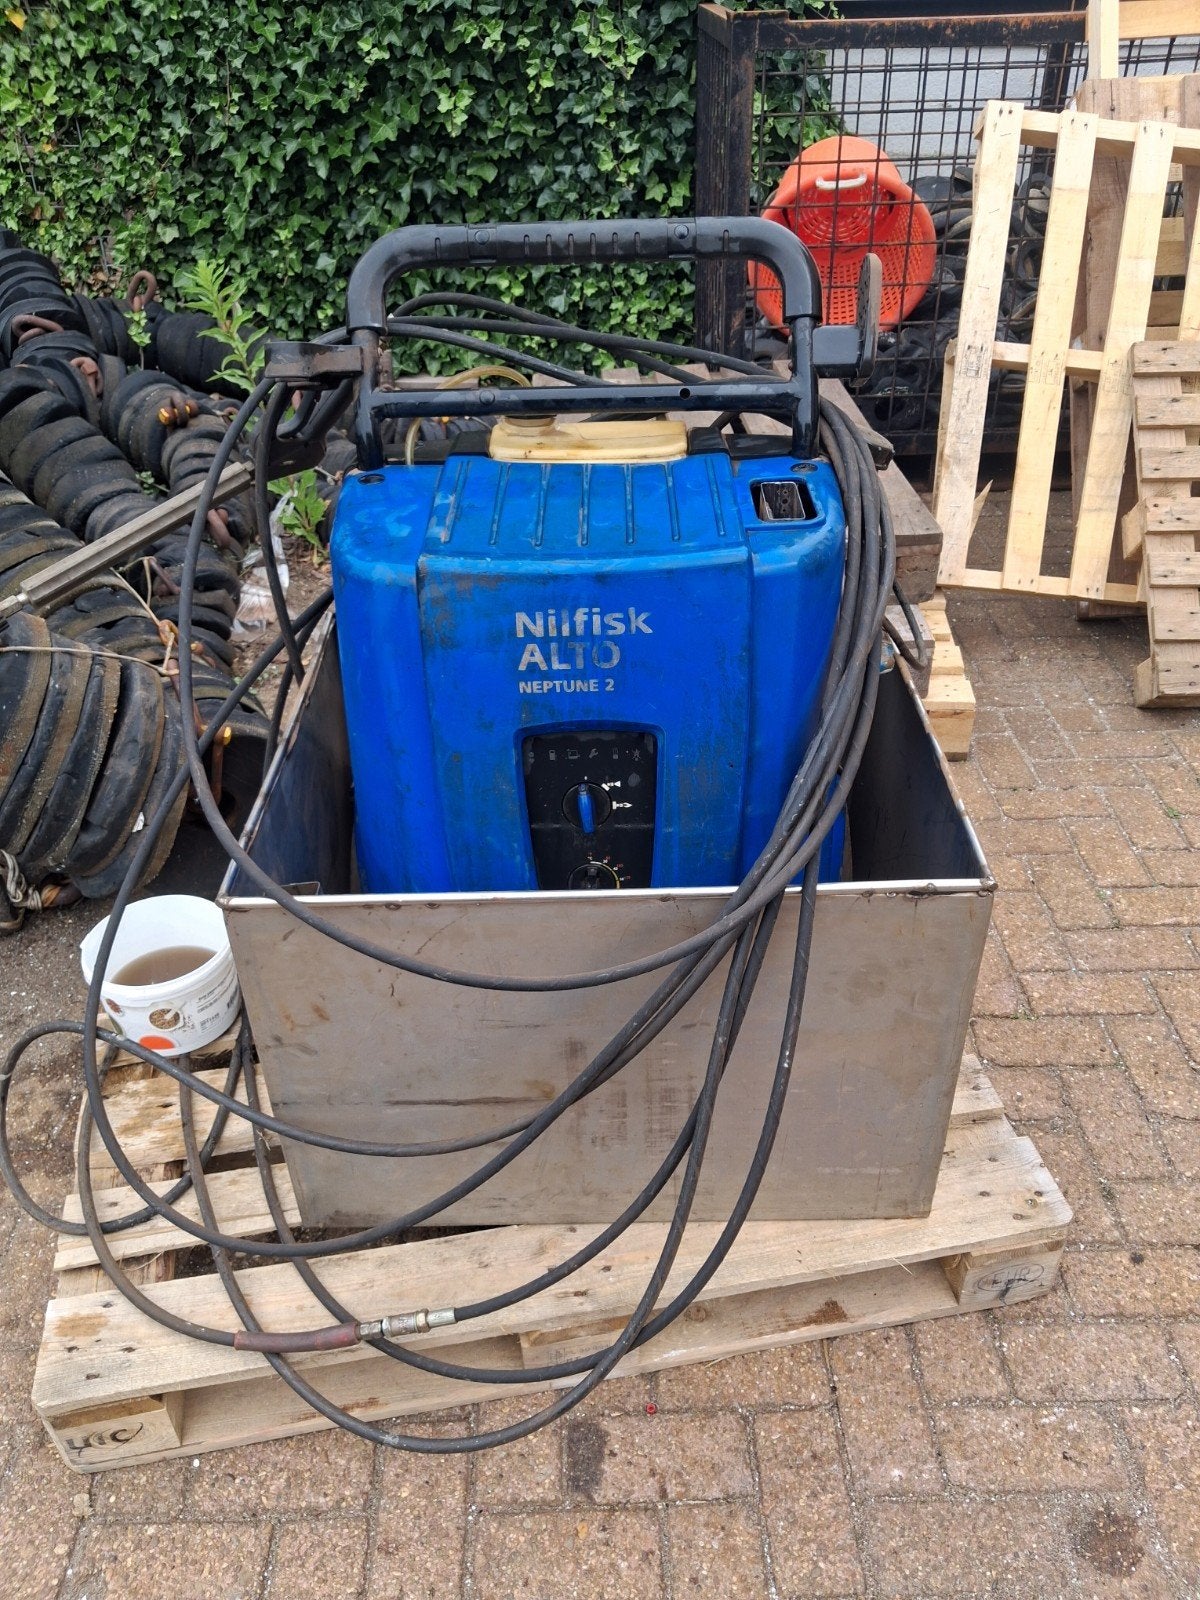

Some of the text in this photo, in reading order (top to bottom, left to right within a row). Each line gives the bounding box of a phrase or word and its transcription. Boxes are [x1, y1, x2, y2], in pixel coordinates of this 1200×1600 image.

[515, 607, 653, 638] Nilfisk
[518, 640, 621, 671] ALTO
[519, 678, 615, 694] NEPTUNE 2
